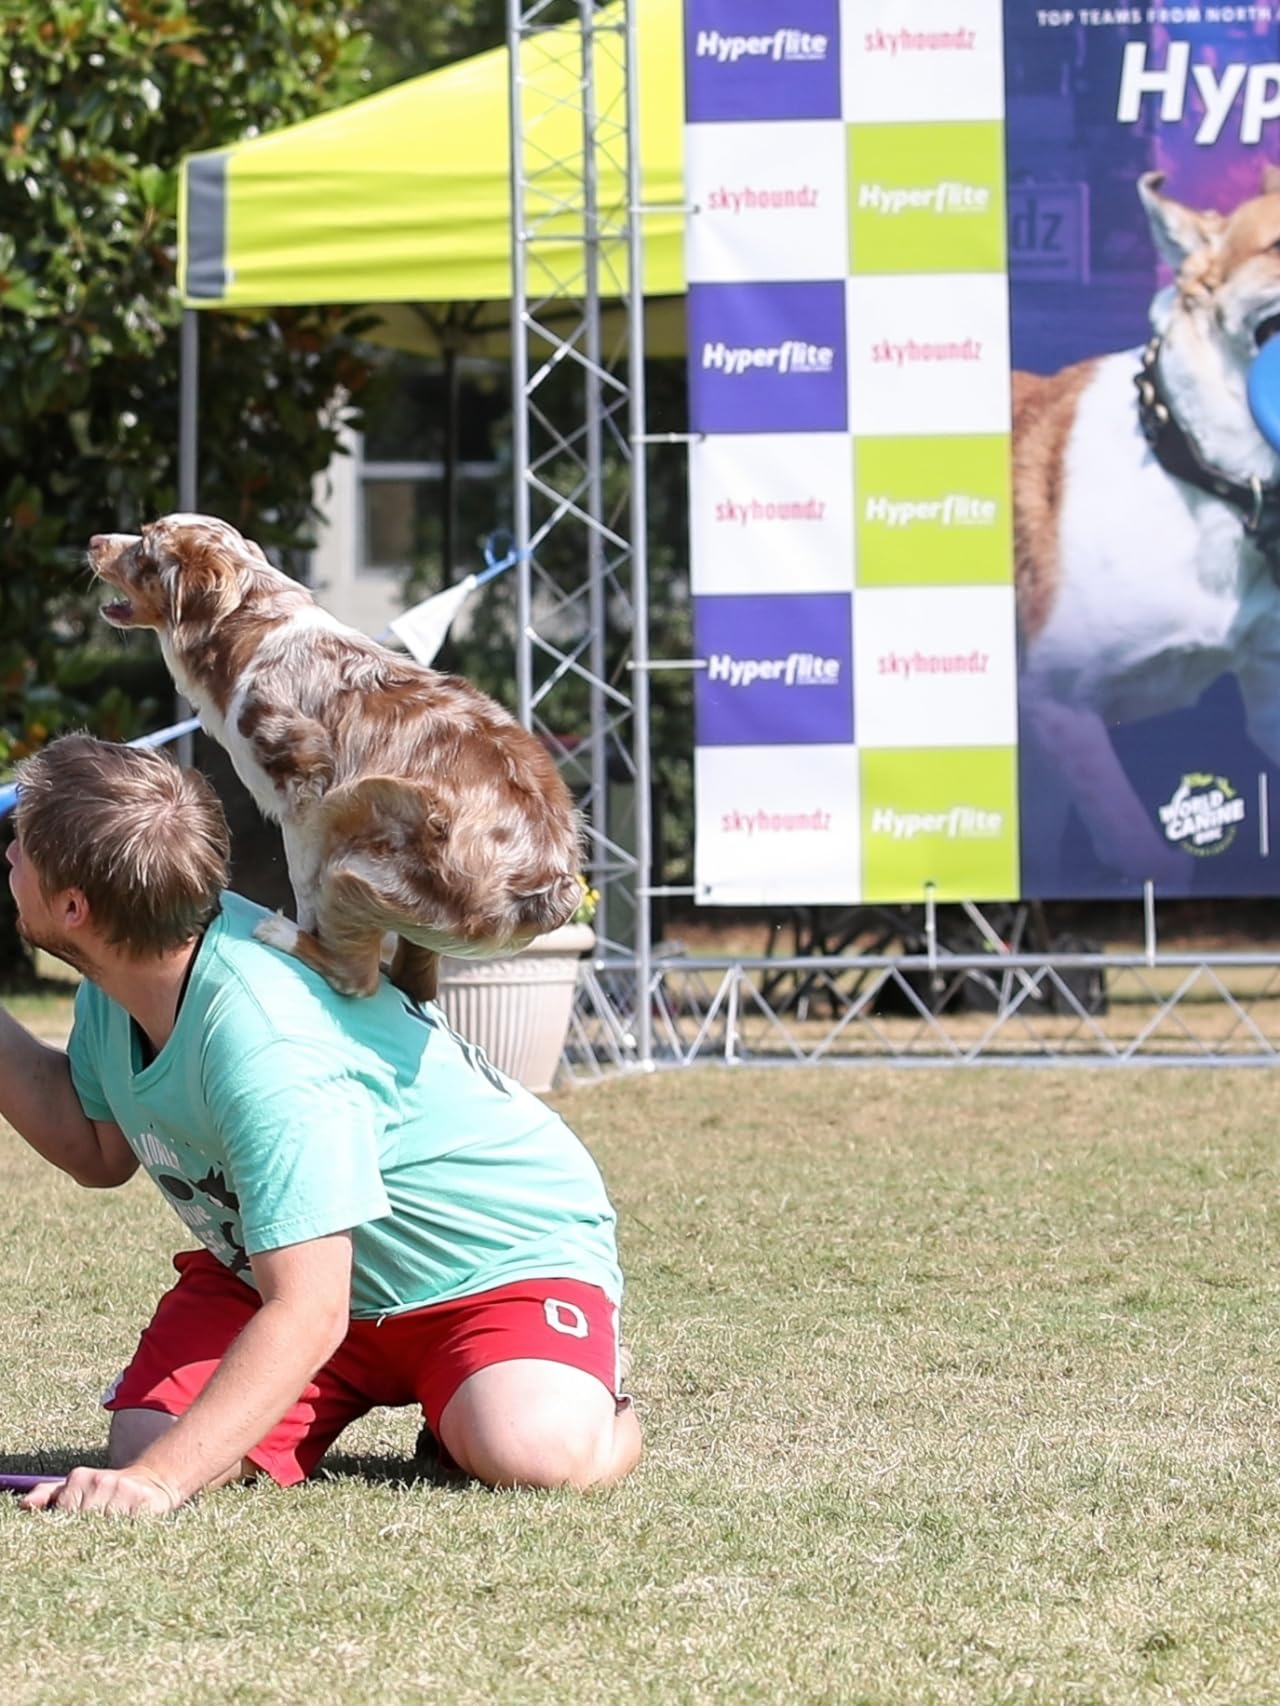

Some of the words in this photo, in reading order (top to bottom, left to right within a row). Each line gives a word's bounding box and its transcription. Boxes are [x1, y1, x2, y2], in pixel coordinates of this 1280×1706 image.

[1037, 9, 1074, 26] TOP
[1080, 8, 1142, 25] TEAMS
[1147, 7, 1201, 23] FROM
[1206, 6, 1270, 22] NORTH
[696, 29, 828, 61] Hyperflite
[865, 28, 976, 54] skyhoundz
[708, 186, 818, 212] skyhoundz
[857, 180, 991, 214] Hyperflite
[702, 340, 834, 374] Hyperflite
[872, 339, 982, 365] skyhoundz
[715, 498, 825, 524] skyhoundz
[864, 493, 998, 527] Hyperflite
[708, 653, 840, 686] Hyperflite
[878, 651, 989, 676] skyhoundz
[722, 810, 830, 834] skyhoundz
[870, 805, 1004, 839] Hyperflite
